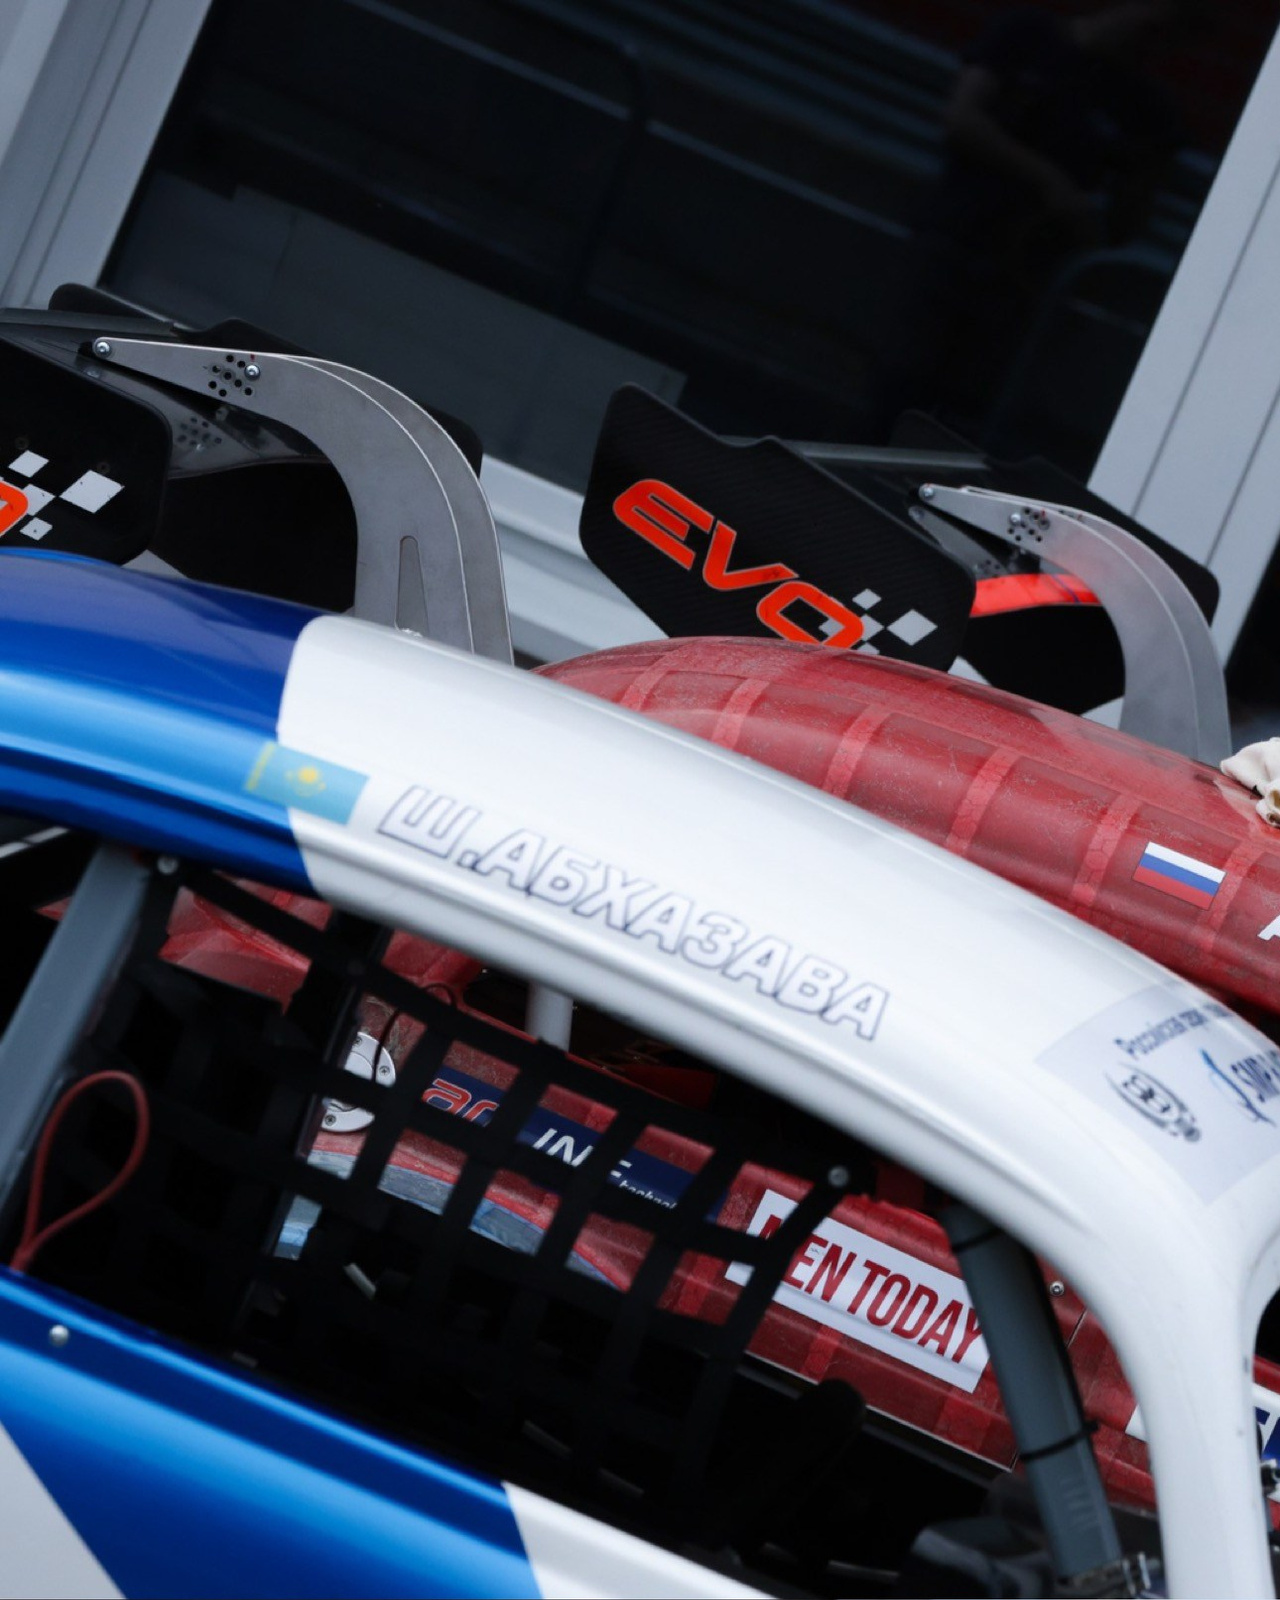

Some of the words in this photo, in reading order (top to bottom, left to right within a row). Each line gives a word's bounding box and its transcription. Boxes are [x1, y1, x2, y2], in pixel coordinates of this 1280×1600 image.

[612, 479, 865, 650] EVO
[377, 785, 890, 1041] Ш.АБХАЗАВА
[847, 1259, 981, 1364] TODAY
